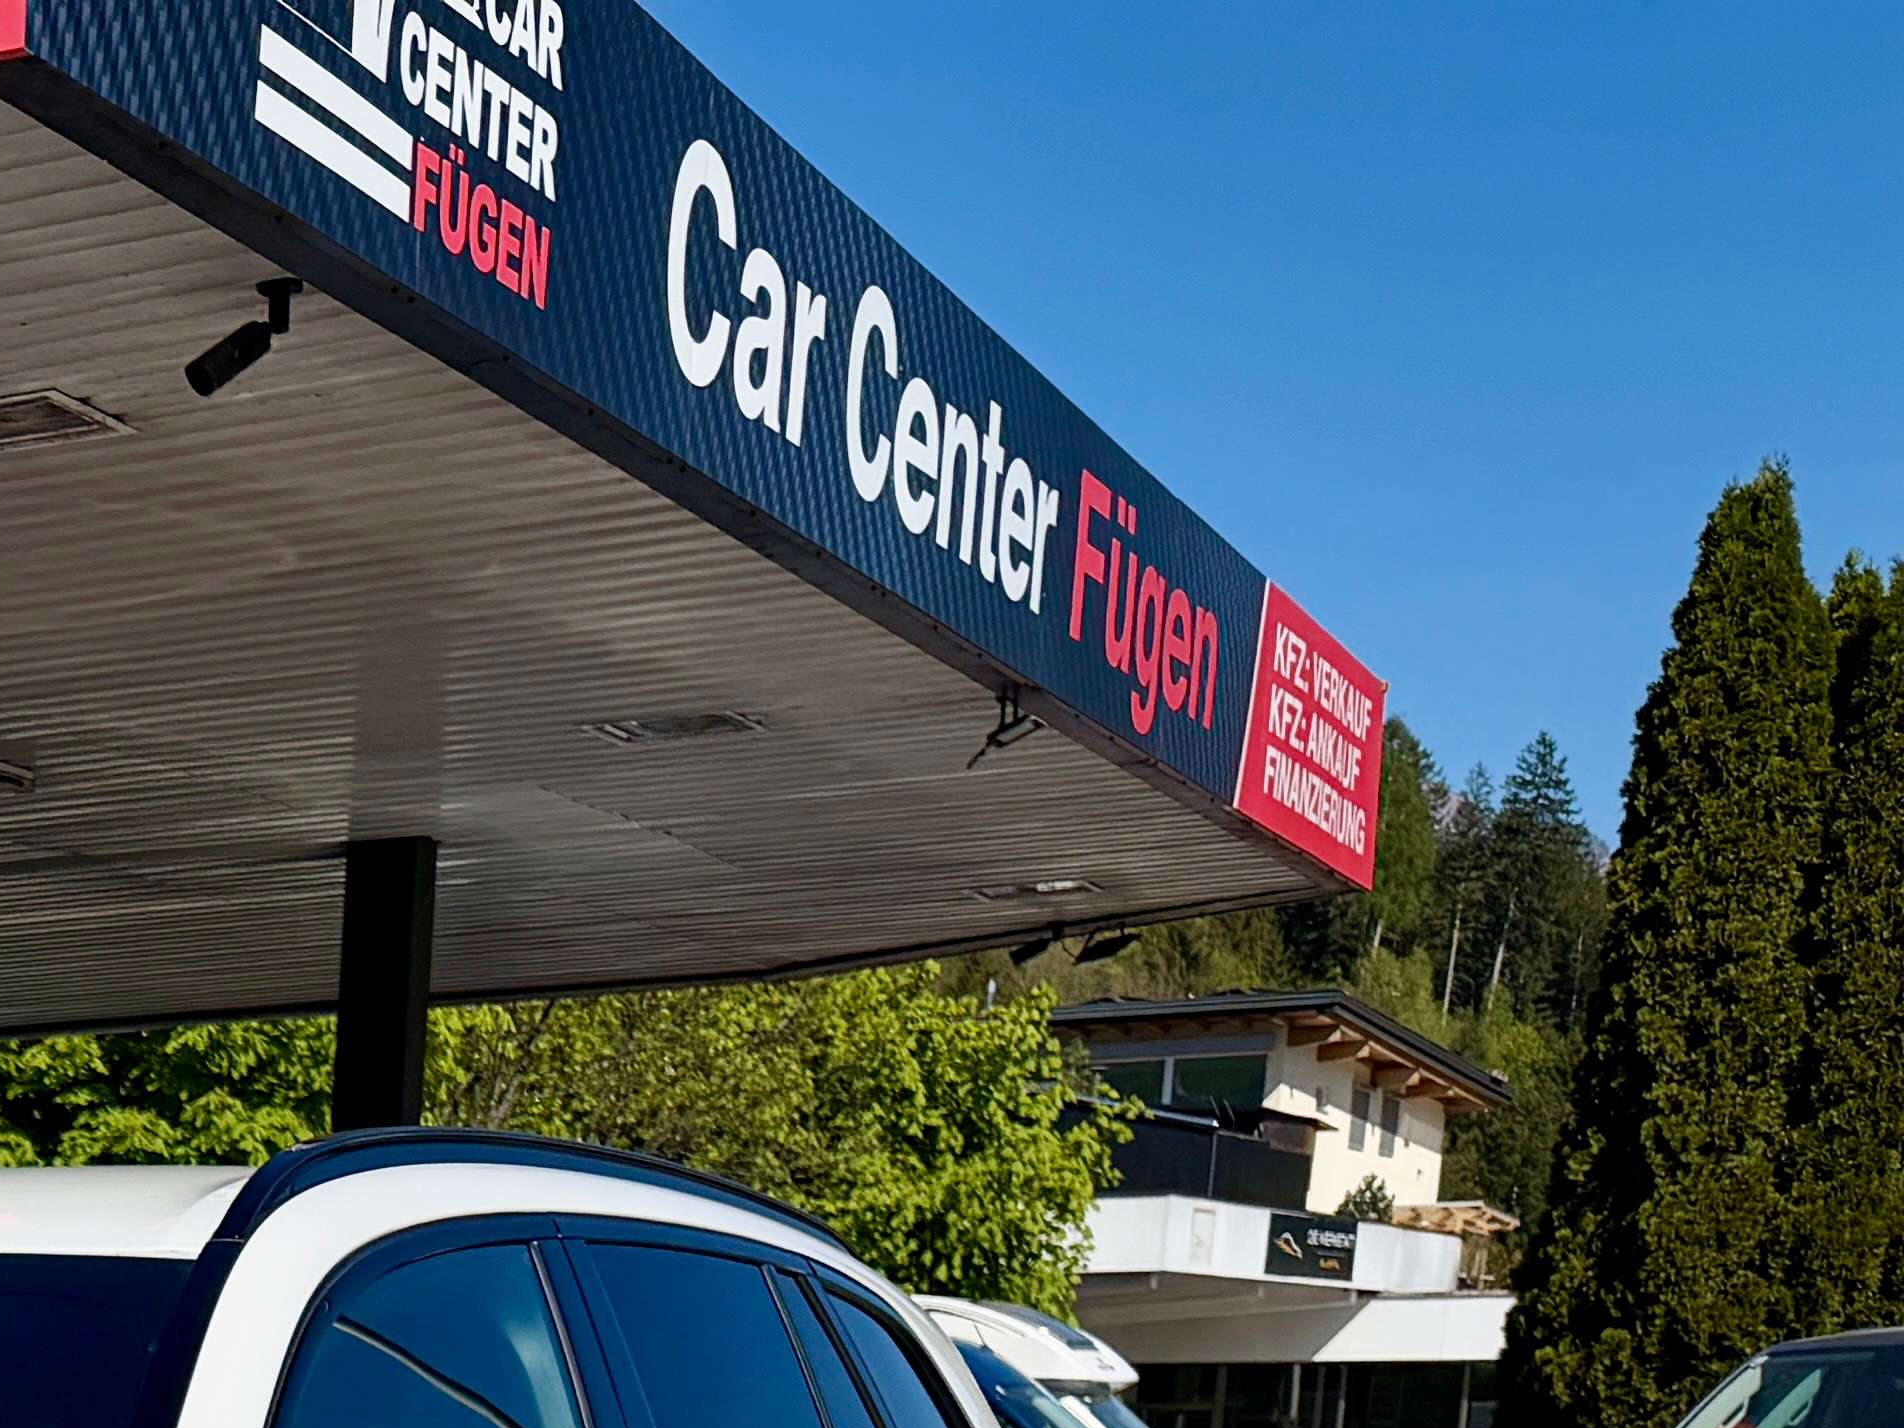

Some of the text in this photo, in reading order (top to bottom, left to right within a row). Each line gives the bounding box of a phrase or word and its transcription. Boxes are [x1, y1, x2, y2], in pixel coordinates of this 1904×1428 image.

[400, 11, 558, 202] CENTER
[414, 143, 551, 310] FÜGEN
[667, 139, 1218, 735] Car Center Fügen
[1306, 713, 1362, 793] ANKAUF
[1312, 651, 1373, 743] VERKAUF
[1263, 745, 1366, 856] FINANZIERUNG
